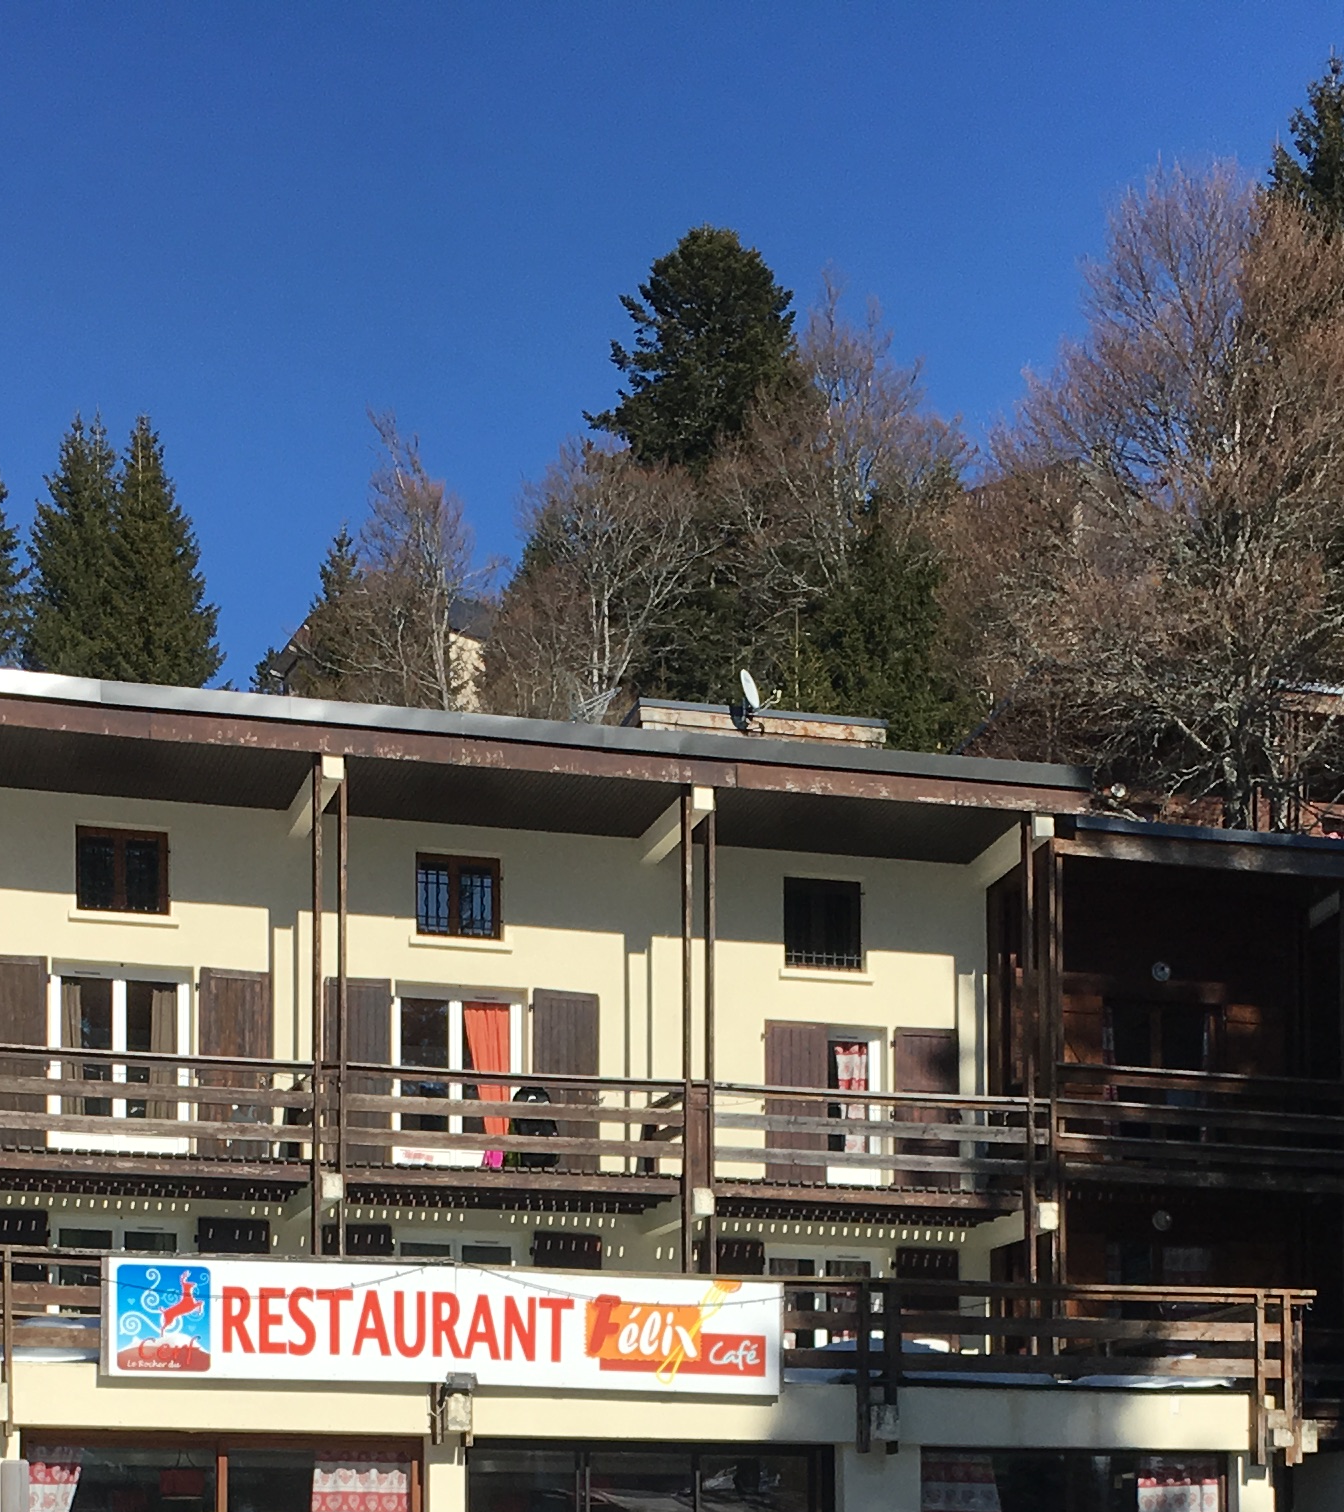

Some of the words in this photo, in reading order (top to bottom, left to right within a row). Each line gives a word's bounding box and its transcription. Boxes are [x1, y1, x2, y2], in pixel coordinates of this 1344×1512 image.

[138, 1336, 201, 1364] Cerf
[222, 1286, 575, 1362] RESTAURANT
[589, 1293, 698, 1358] Félix
[709, 1339, 760, 1370] Café
